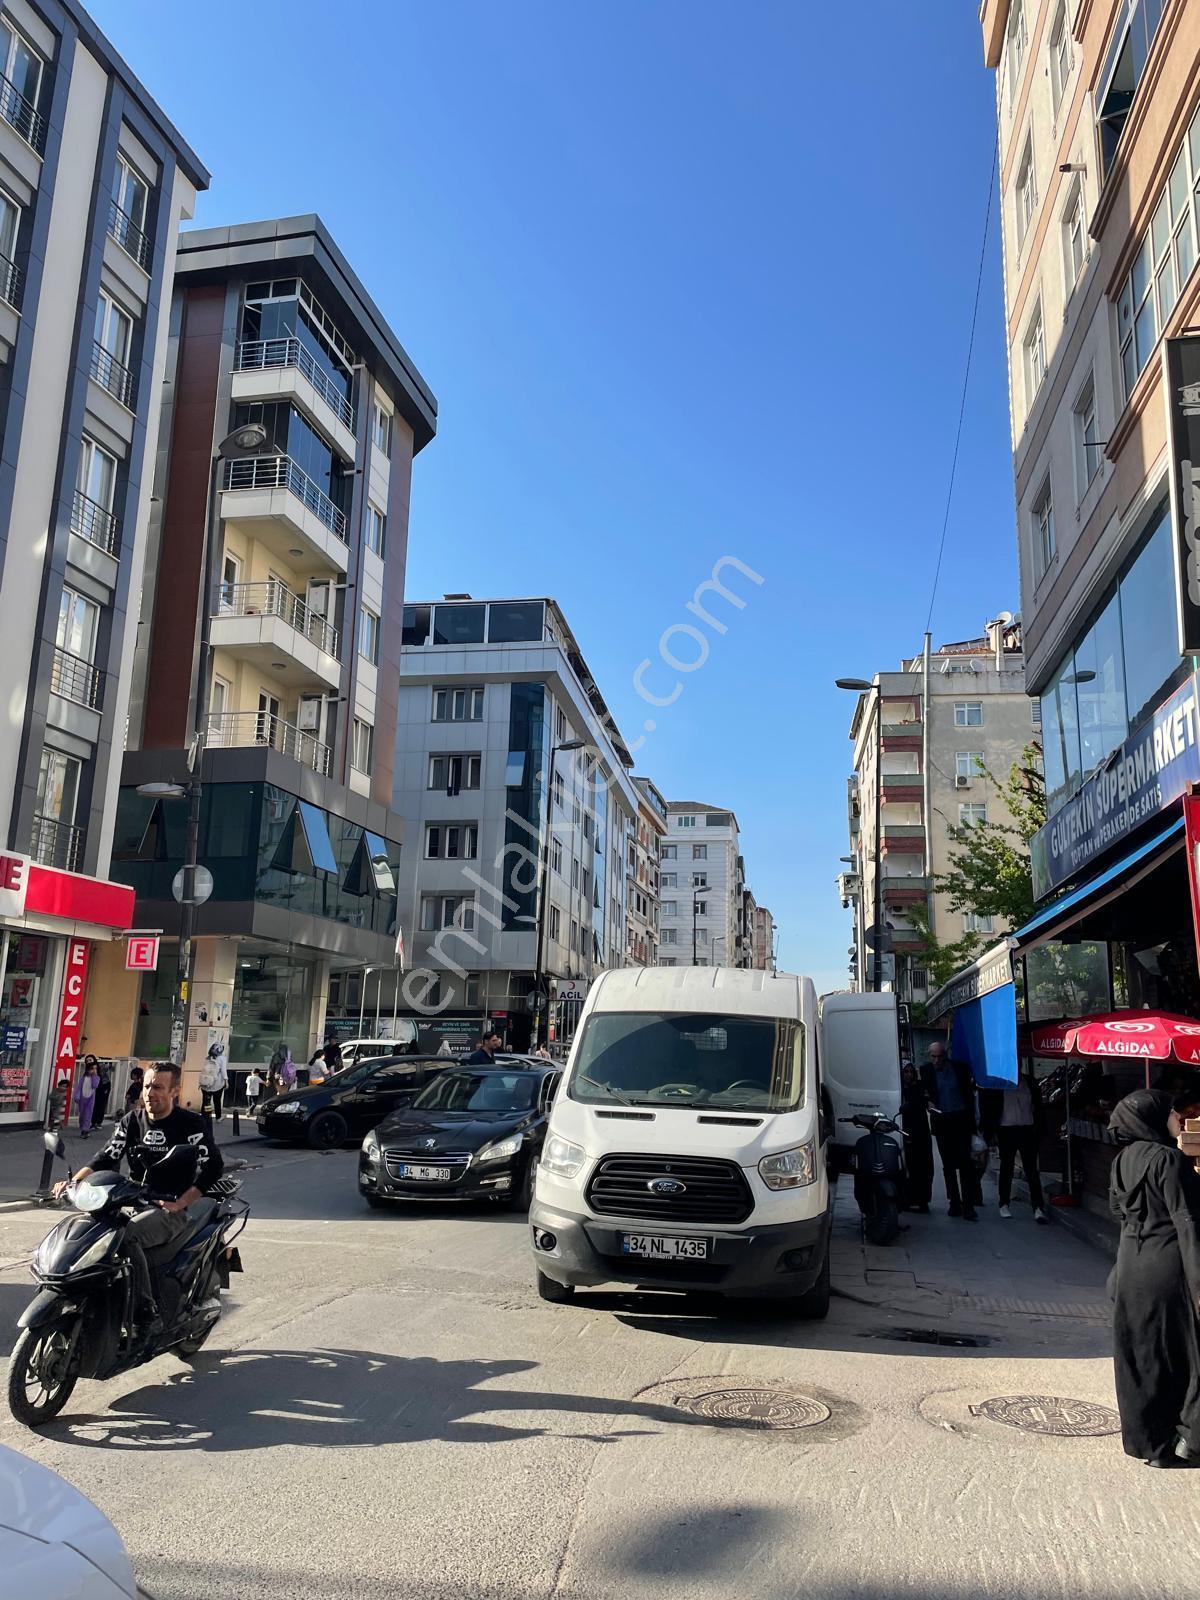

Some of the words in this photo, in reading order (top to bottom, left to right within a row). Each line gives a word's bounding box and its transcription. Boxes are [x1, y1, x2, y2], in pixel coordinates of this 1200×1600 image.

[134, 943, 149, 963] E
[405, 1166, 413, 1176] 34
[420, 1167, 430, 1177] MG
[435, 1168, 449, 1179] 330
[656, 1182, 678, 1192] Ford
[630, 1237, 646, 1252] 34
[650, 1238, 670, 1254] NL
[674, 1240, 706, 1257] 1435
